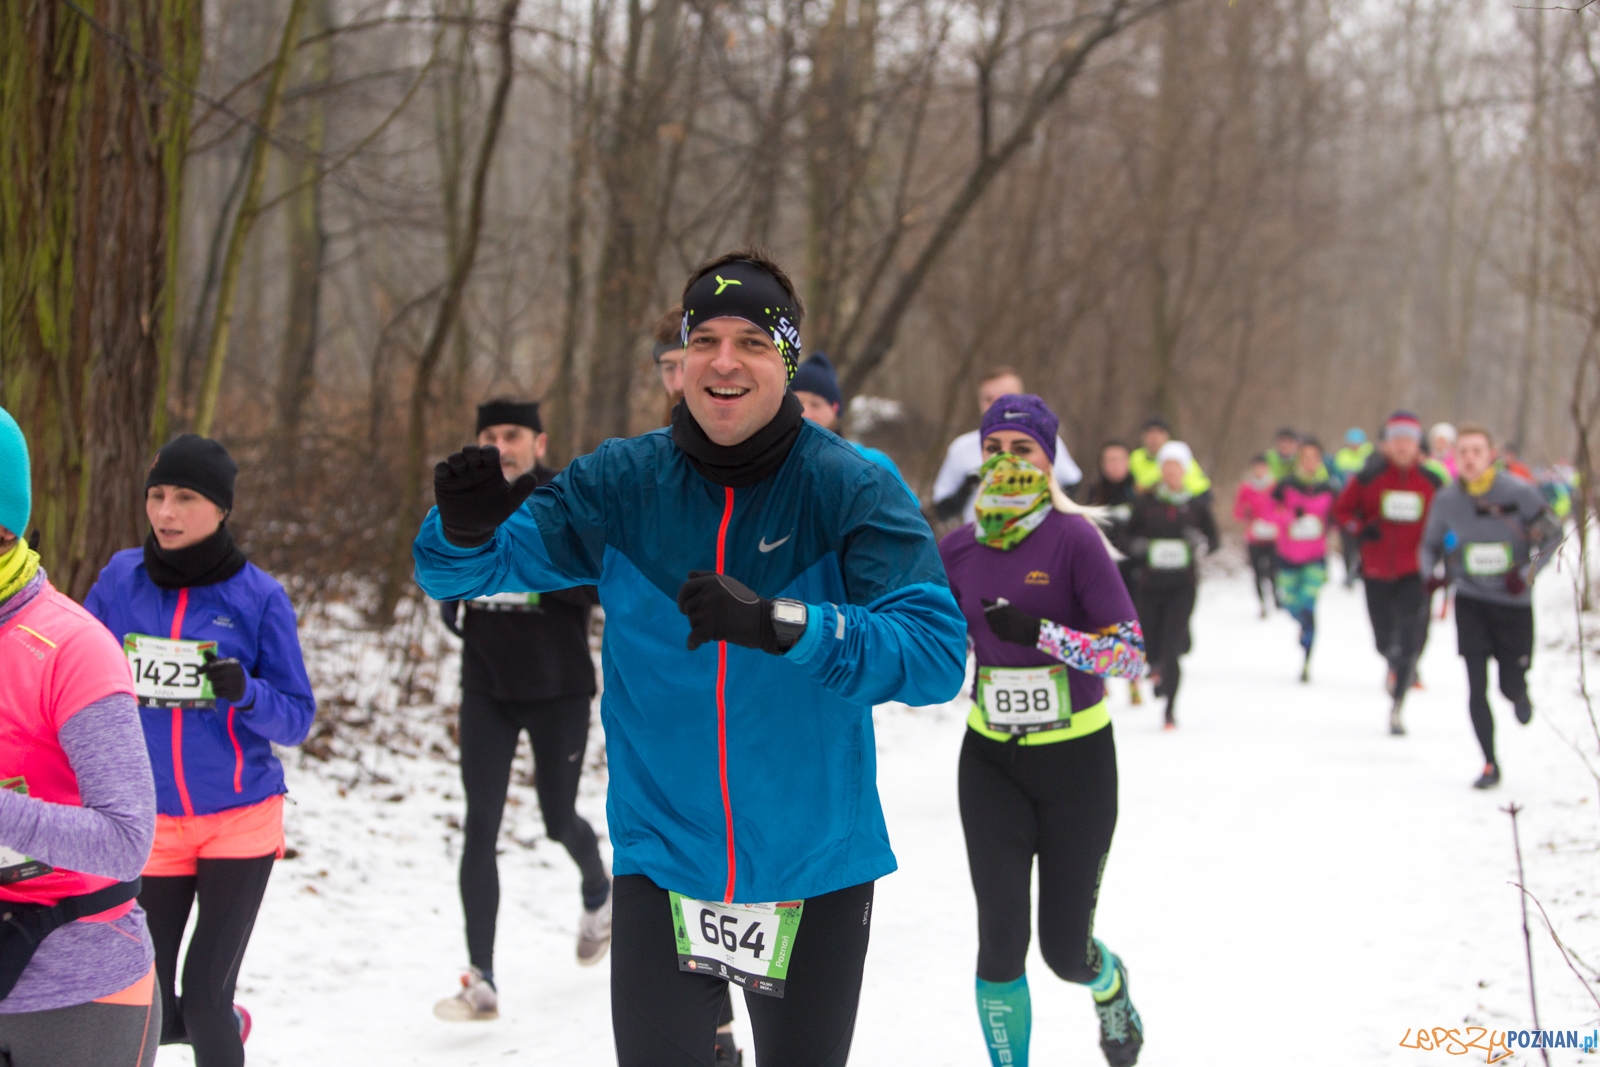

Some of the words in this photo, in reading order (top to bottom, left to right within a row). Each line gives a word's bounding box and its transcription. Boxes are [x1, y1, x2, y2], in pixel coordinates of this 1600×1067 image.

[133, 658, 200, 687] 1423
[153, 689, 174, 697] ANNA
[996, 689, 1050, 713] 838
[700, 908, 765, 959] 664
[775, 935, 790, 968] Poznań
[983, 999, 1014, 1067] alenji
